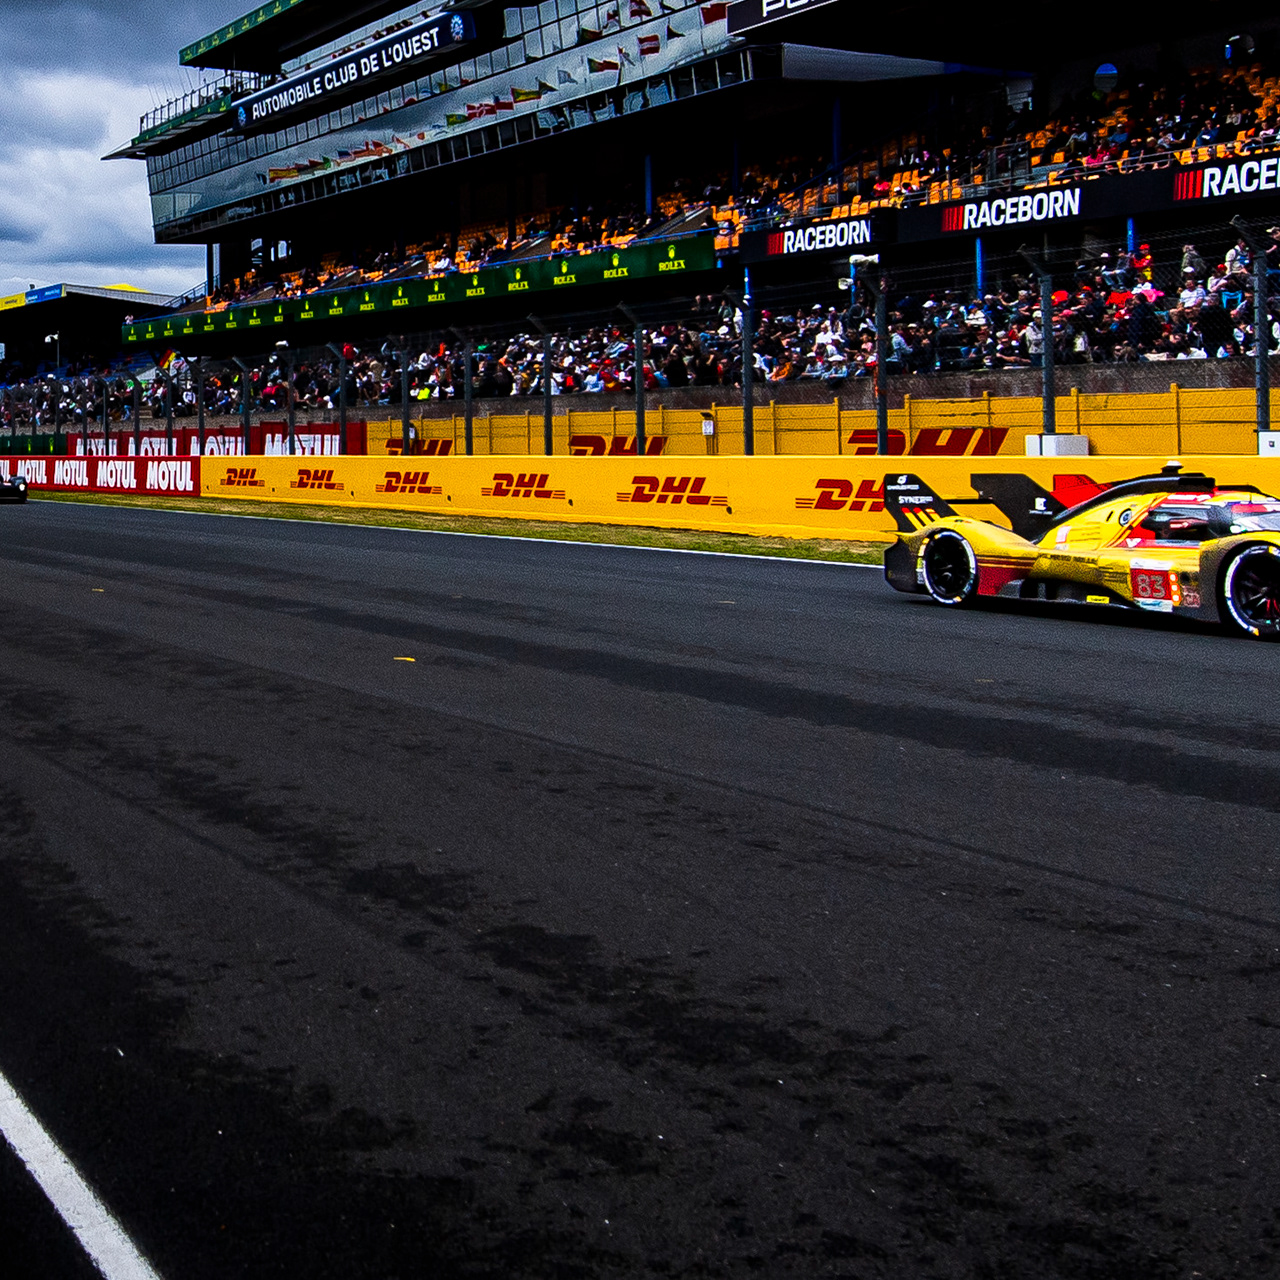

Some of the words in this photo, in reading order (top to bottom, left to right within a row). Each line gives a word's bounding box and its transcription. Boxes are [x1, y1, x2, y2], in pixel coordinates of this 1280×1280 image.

[252, 77, 322, 120] AUTOMOBILE
[324, 63, 358, 90] CLUB
[360, 54, 379, 77] DE
[382, 27, 439, 67] L'OUEST
[964, 188, 1080, 229] RACEBORN
[784, 220, 871, 254] RACEBORN
[604, 267, 628, 278] ROLEX
[659, 259, 685, 271] ROLEX
[466, 287, 485, 297] ROLEX
[508, 281, 529, 291] ROLEX
[554, 275, 576, 285] ROLEX
[17, 460, 47, 483] MOTUL
[54, 460, 89, 486] MOTUL
[97, 460, 137, 489] MOTUL
[146, 460, 194, 491] MOTUL
[226, 468, 259, 487] DHL
[297, 470, 338, 489] DHL
[384, 472, 432, 494] DHL
[492, 474, 552, 498] DHL
[631, 476, 712, 506] DHL
[815, 479, 885, 512] DH
[1136, 574, 1167, 599] 83
